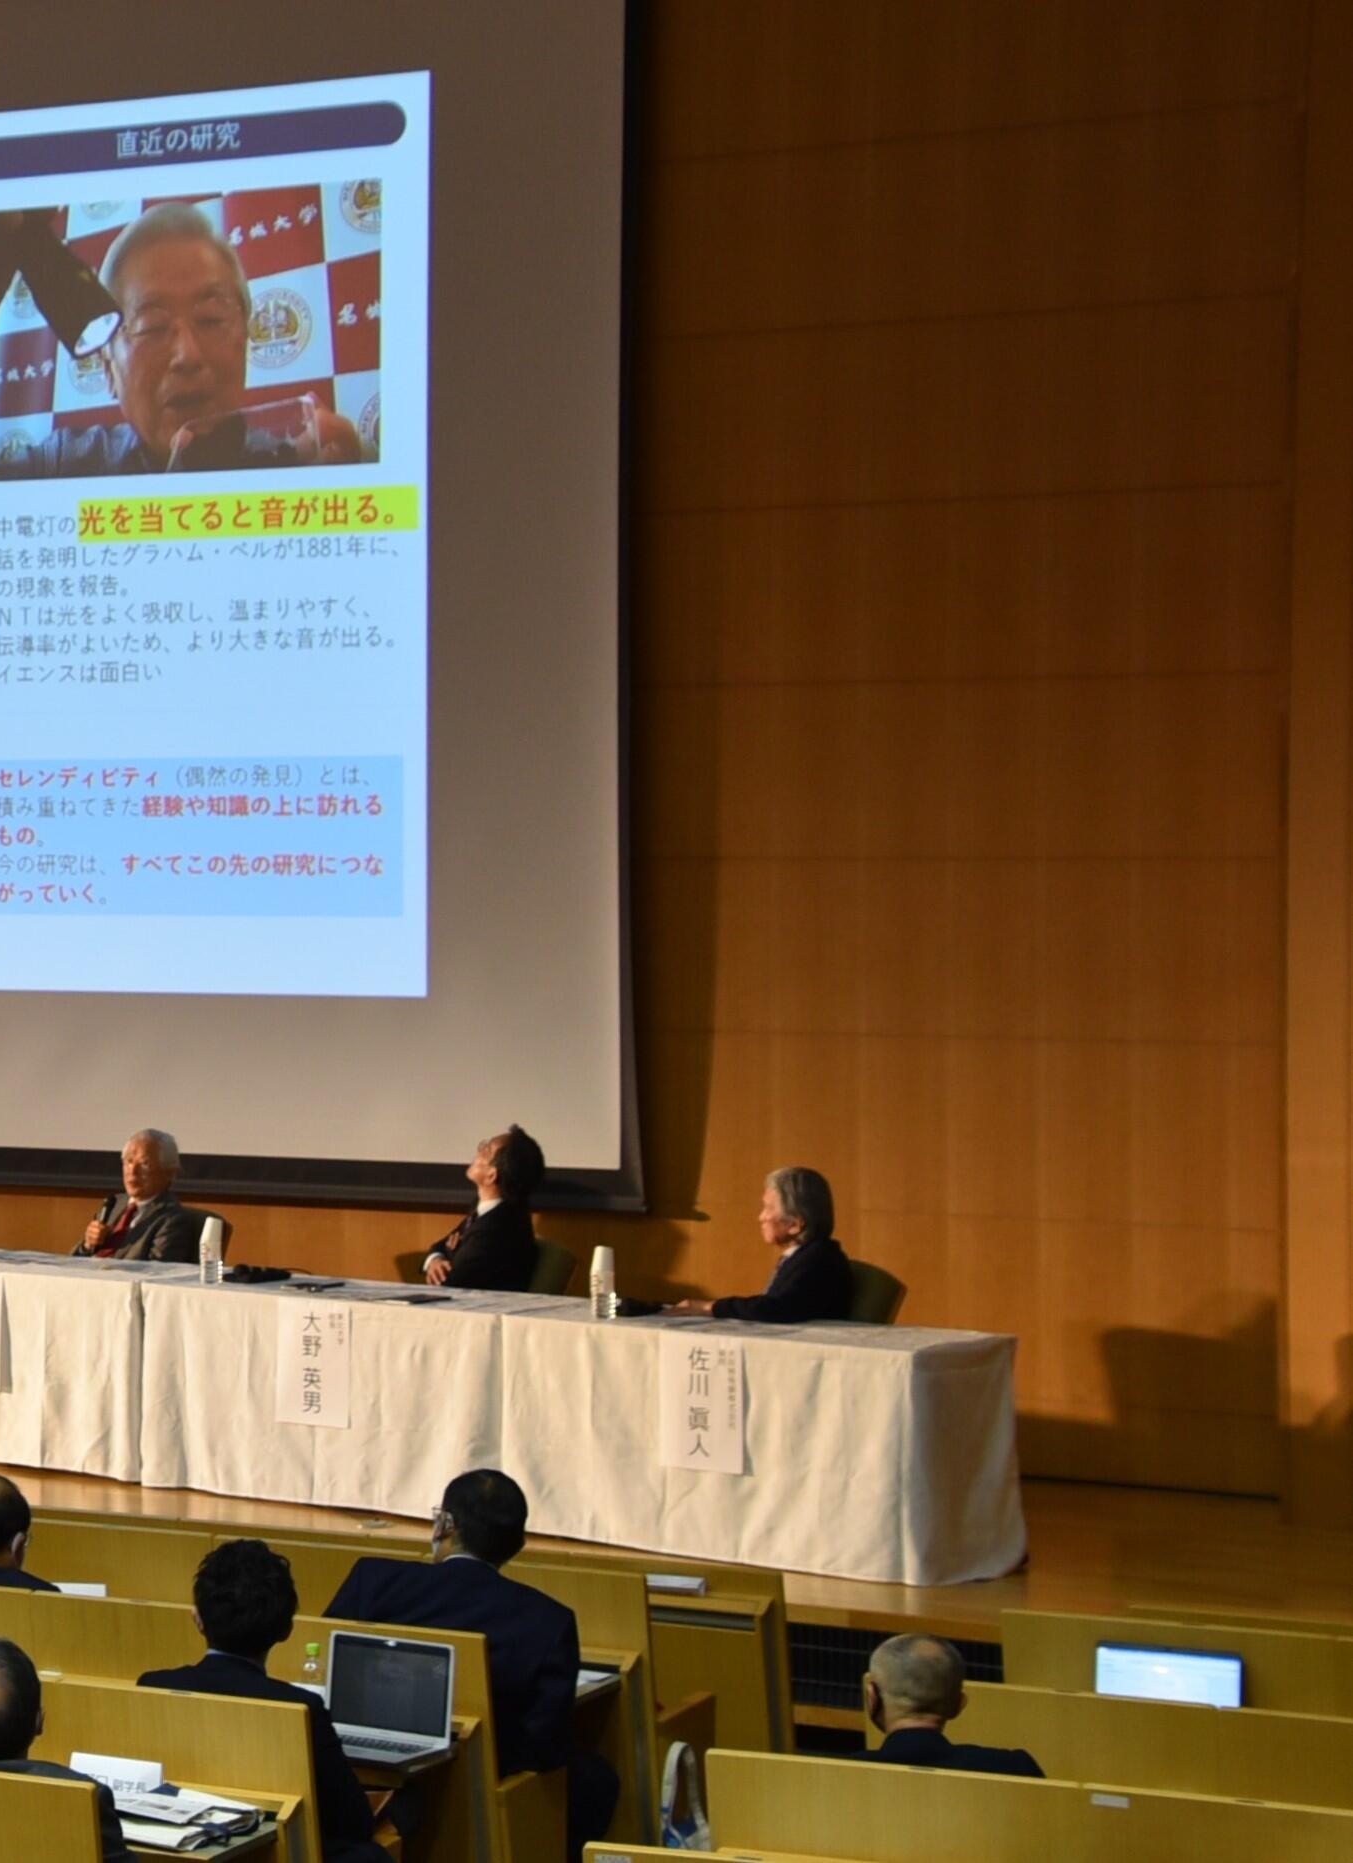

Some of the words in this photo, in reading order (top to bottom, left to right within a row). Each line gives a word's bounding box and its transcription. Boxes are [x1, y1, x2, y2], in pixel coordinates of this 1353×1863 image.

[115, 121, 242, 160] 直近の研究
[302, 1311, 323, 1358] 大野
[302, 1367, 322, 1414] 英男
[688, 1346, 712, 1398] 佐川
